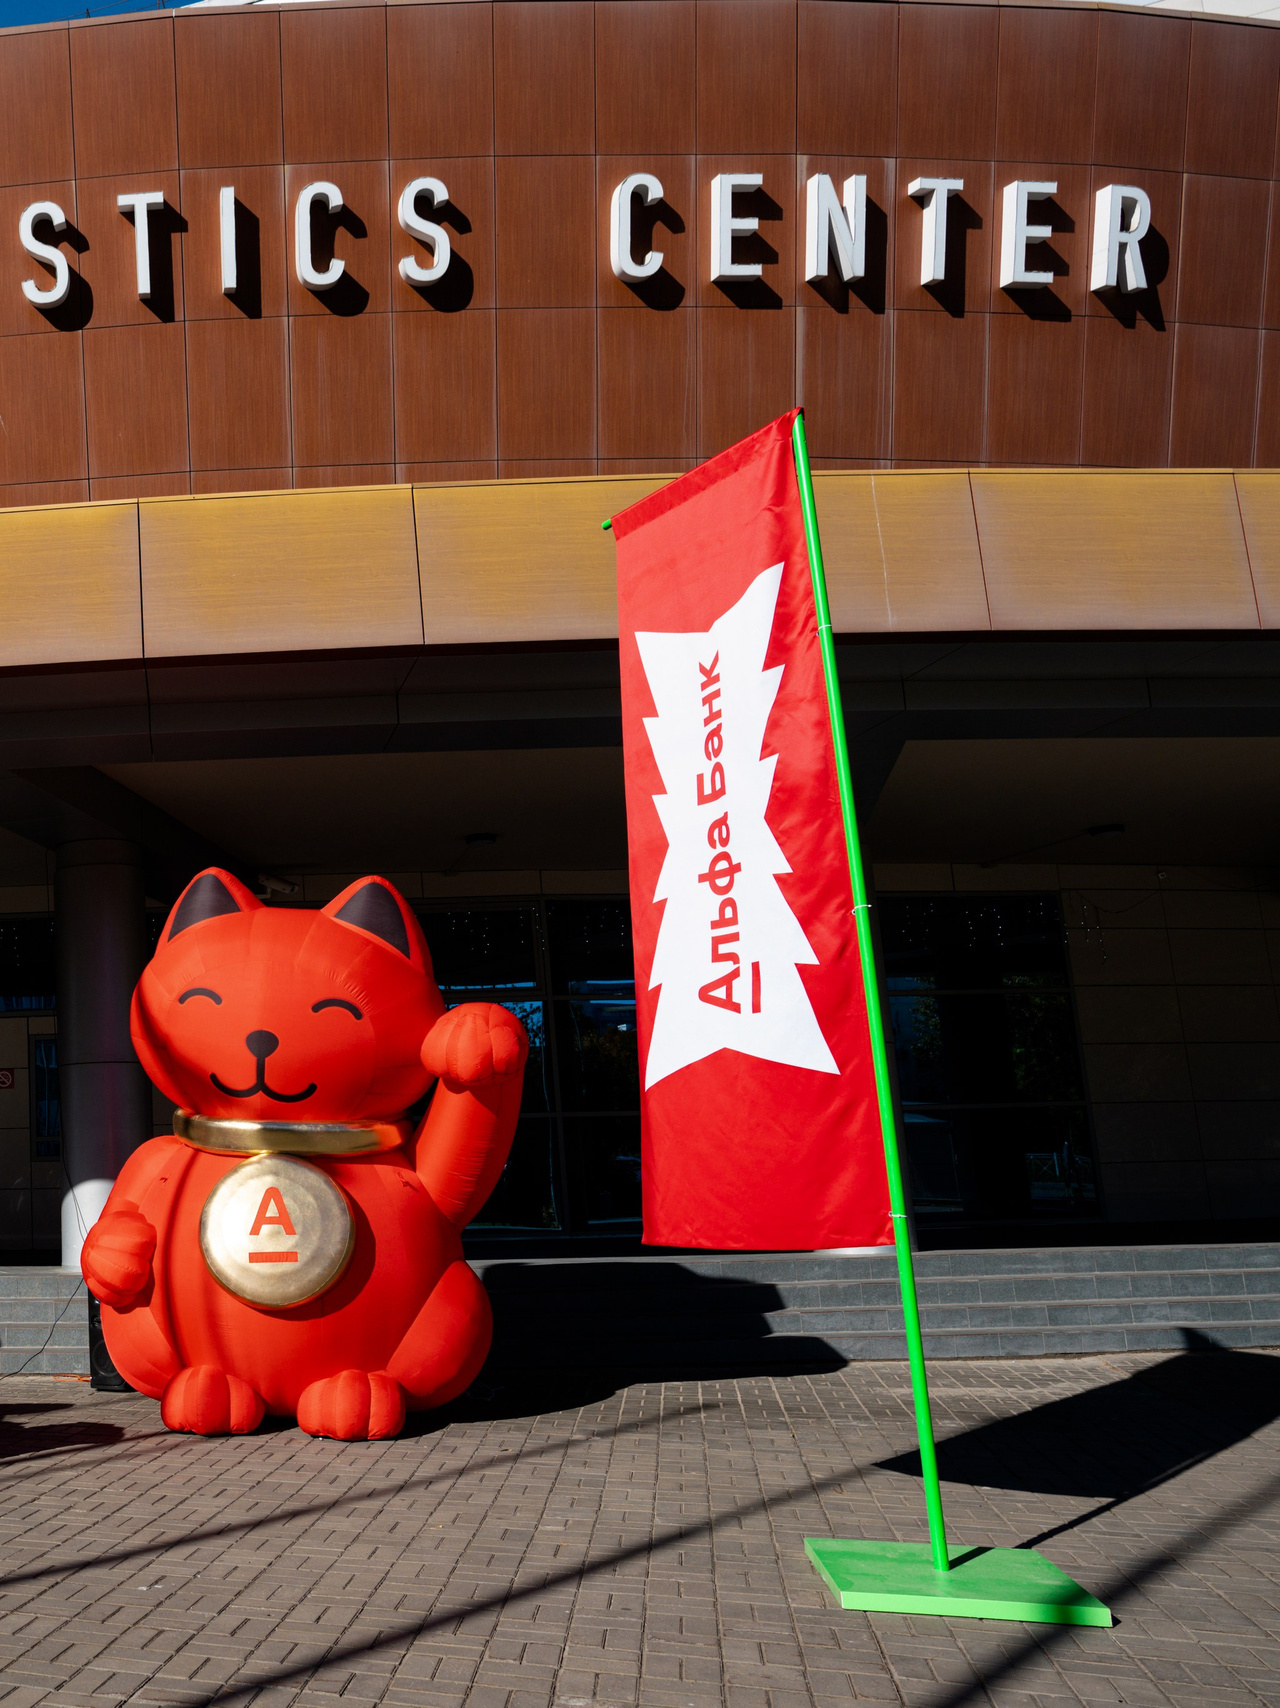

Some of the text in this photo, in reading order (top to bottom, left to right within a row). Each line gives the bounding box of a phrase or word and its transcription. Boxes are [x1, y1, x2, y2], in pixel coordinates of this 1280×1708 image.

[610, 173, 1151, 293] CENTER
[696, 649, 741, 1014] Альфа Банк
